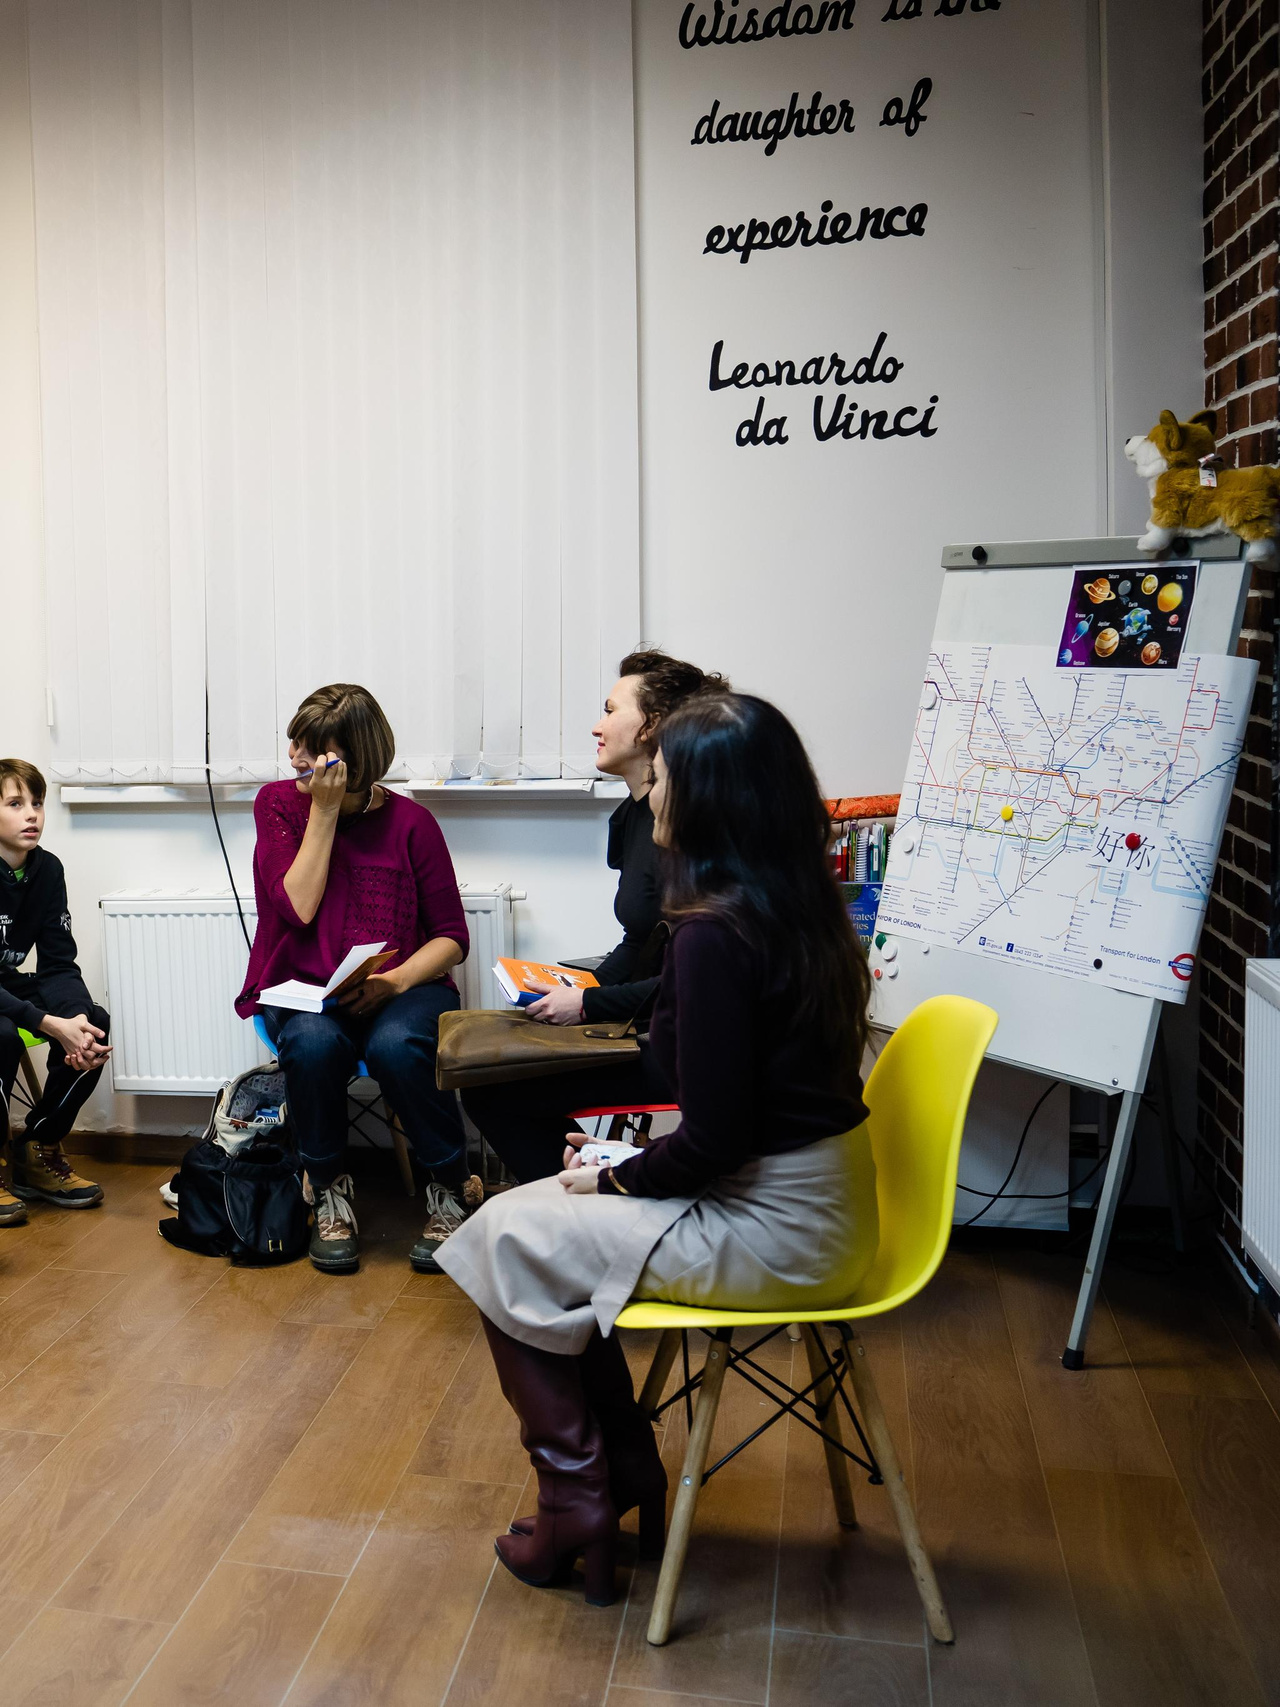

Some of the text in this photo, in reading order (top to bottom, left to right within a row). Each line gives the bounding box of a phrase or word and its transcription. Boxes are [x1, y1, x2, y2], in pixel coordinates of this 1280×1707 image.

[679, 0, 855, 49] Wisdom
[691, 78, 932, 156] daughter of
[703, 200, 928, 263] experience
[710, 332, 904, 391] Leonardo
[736, 394, 939, 446] da Vinci
[849, 911, 876, 921] trated
[852, 922, 869, 930] ries
[900, 919, 922, 929] LONDON
[1100, 945, 1161, 964] Transport for London
